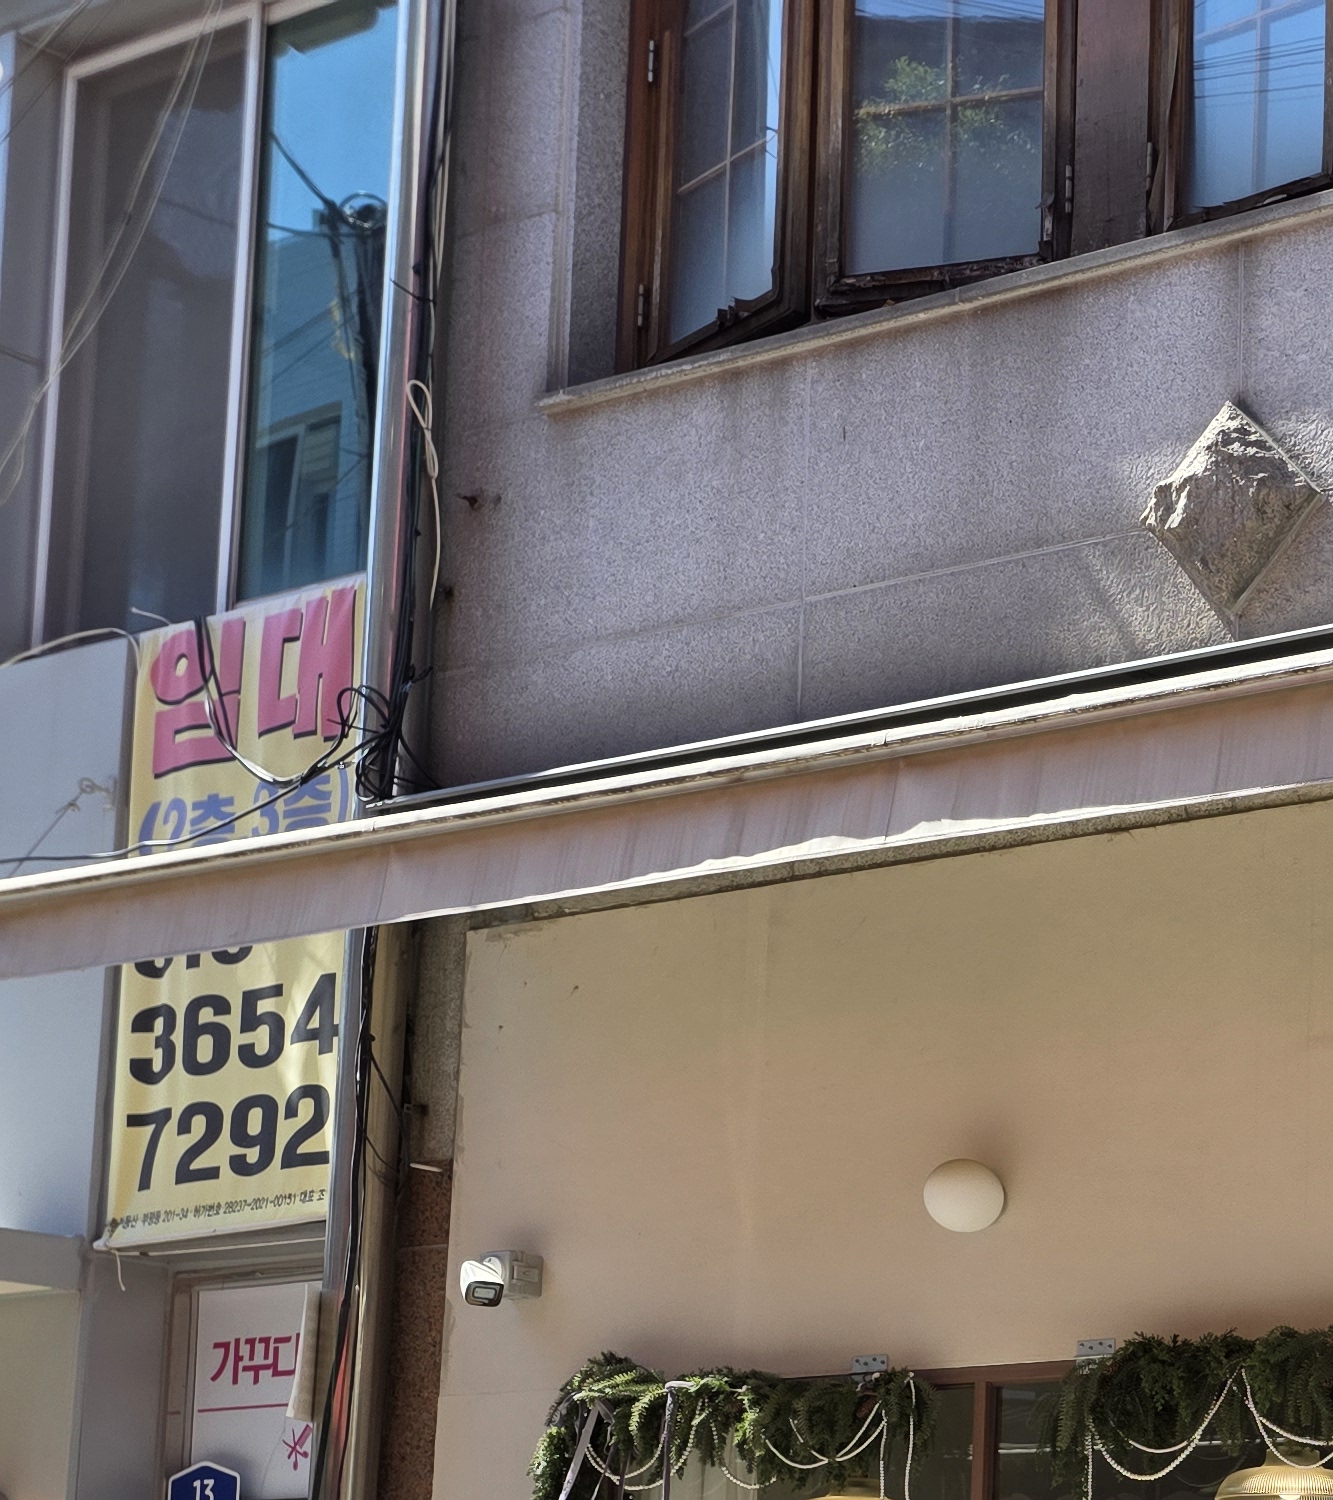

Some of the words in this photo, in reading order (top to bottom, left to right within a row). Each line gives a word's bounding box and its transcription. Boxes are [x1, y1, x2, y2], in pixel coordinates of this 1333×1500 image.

[151, 584, 357, 780] 임대
[129, 973, 339, 1085] 3654
[126, 1084, 331, 1192] 7292
